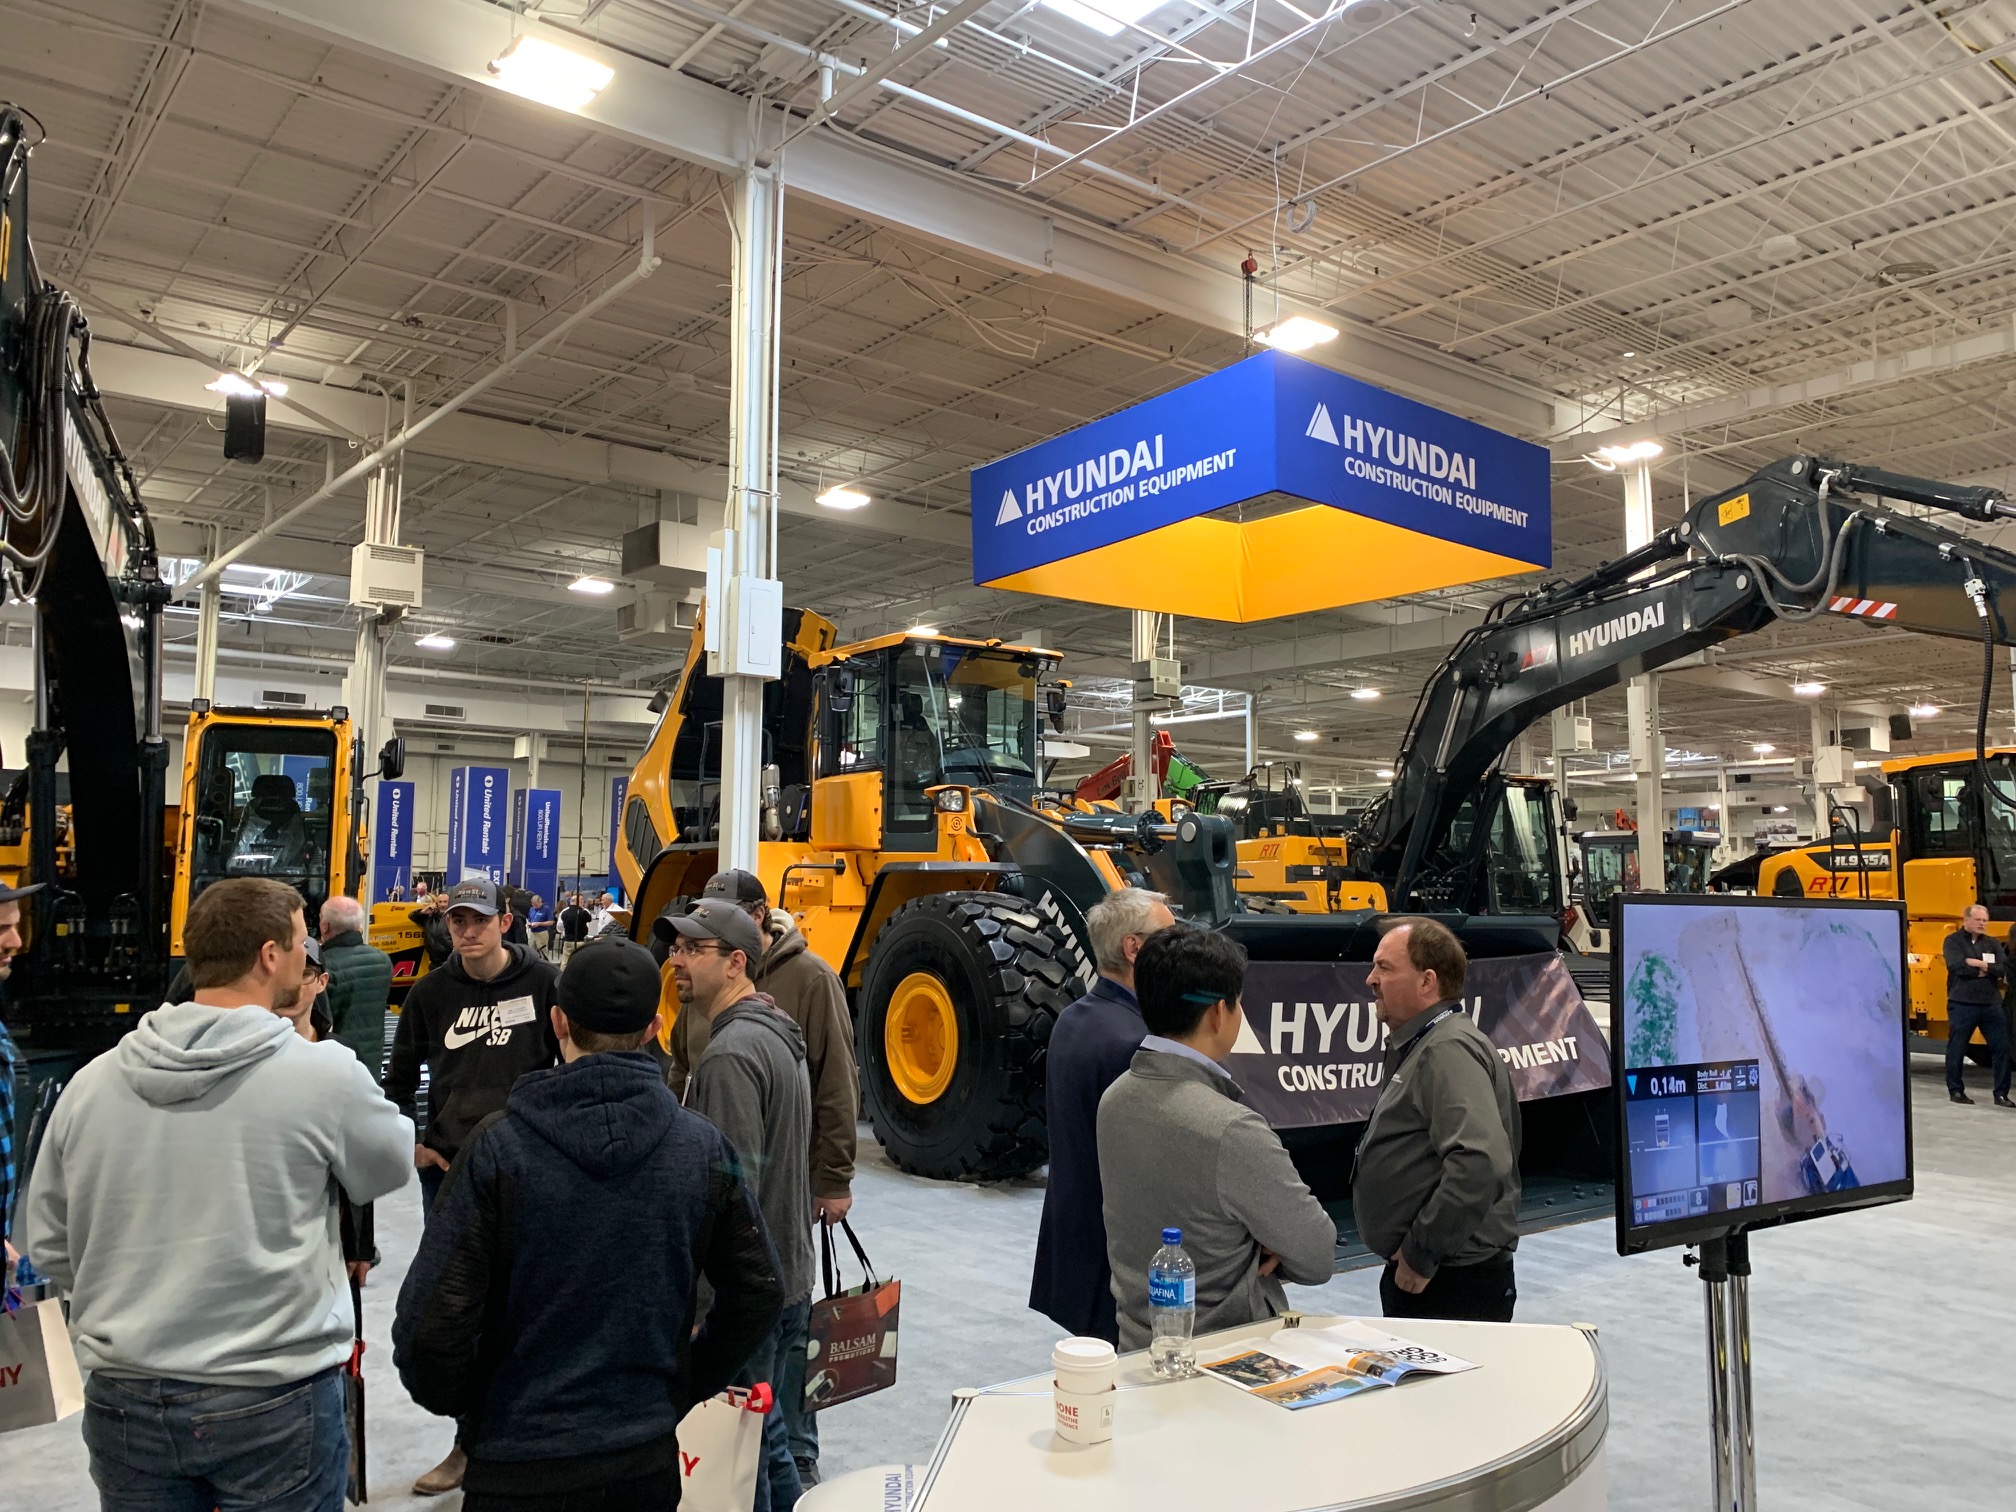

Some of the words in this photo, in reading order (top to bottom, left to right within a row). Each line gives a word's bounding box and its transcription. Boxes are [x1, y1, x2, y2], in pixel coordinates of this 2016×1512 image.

[1344, 414, 1476, 490] HYUNDAI
[64, 407, 105, 536] HYUNDAI
[1026, 433, 1164, 515] HYUNDAI
[1027, 484, 1135, 535] CONSTRUCTION
[1139, 448, 1237, 498] EQUIPMENT
[1344, 456, 1452, 506] CONSTRUCTION
[1456, 492, 1529, 528] EQUIPMENT
[1569, 601, 1665, 657] HYUNDAI
[390, 800, 399, 827] United
[483, 790, 493, 820] United
[389, 827, 399, 858] Rentals
[482, 821, 491, 854] Rentals
[1259, 844, 1281, 857] RTI
[1808, 876, 1850, 891] RTI
[455, 1006, 502, 1028] NIKE
[486, 1029, 512, 1046] SB
[828, 1346, 876, 1363] PROMOTIONS
[830, 1332, 876, 1354] BALSAM
